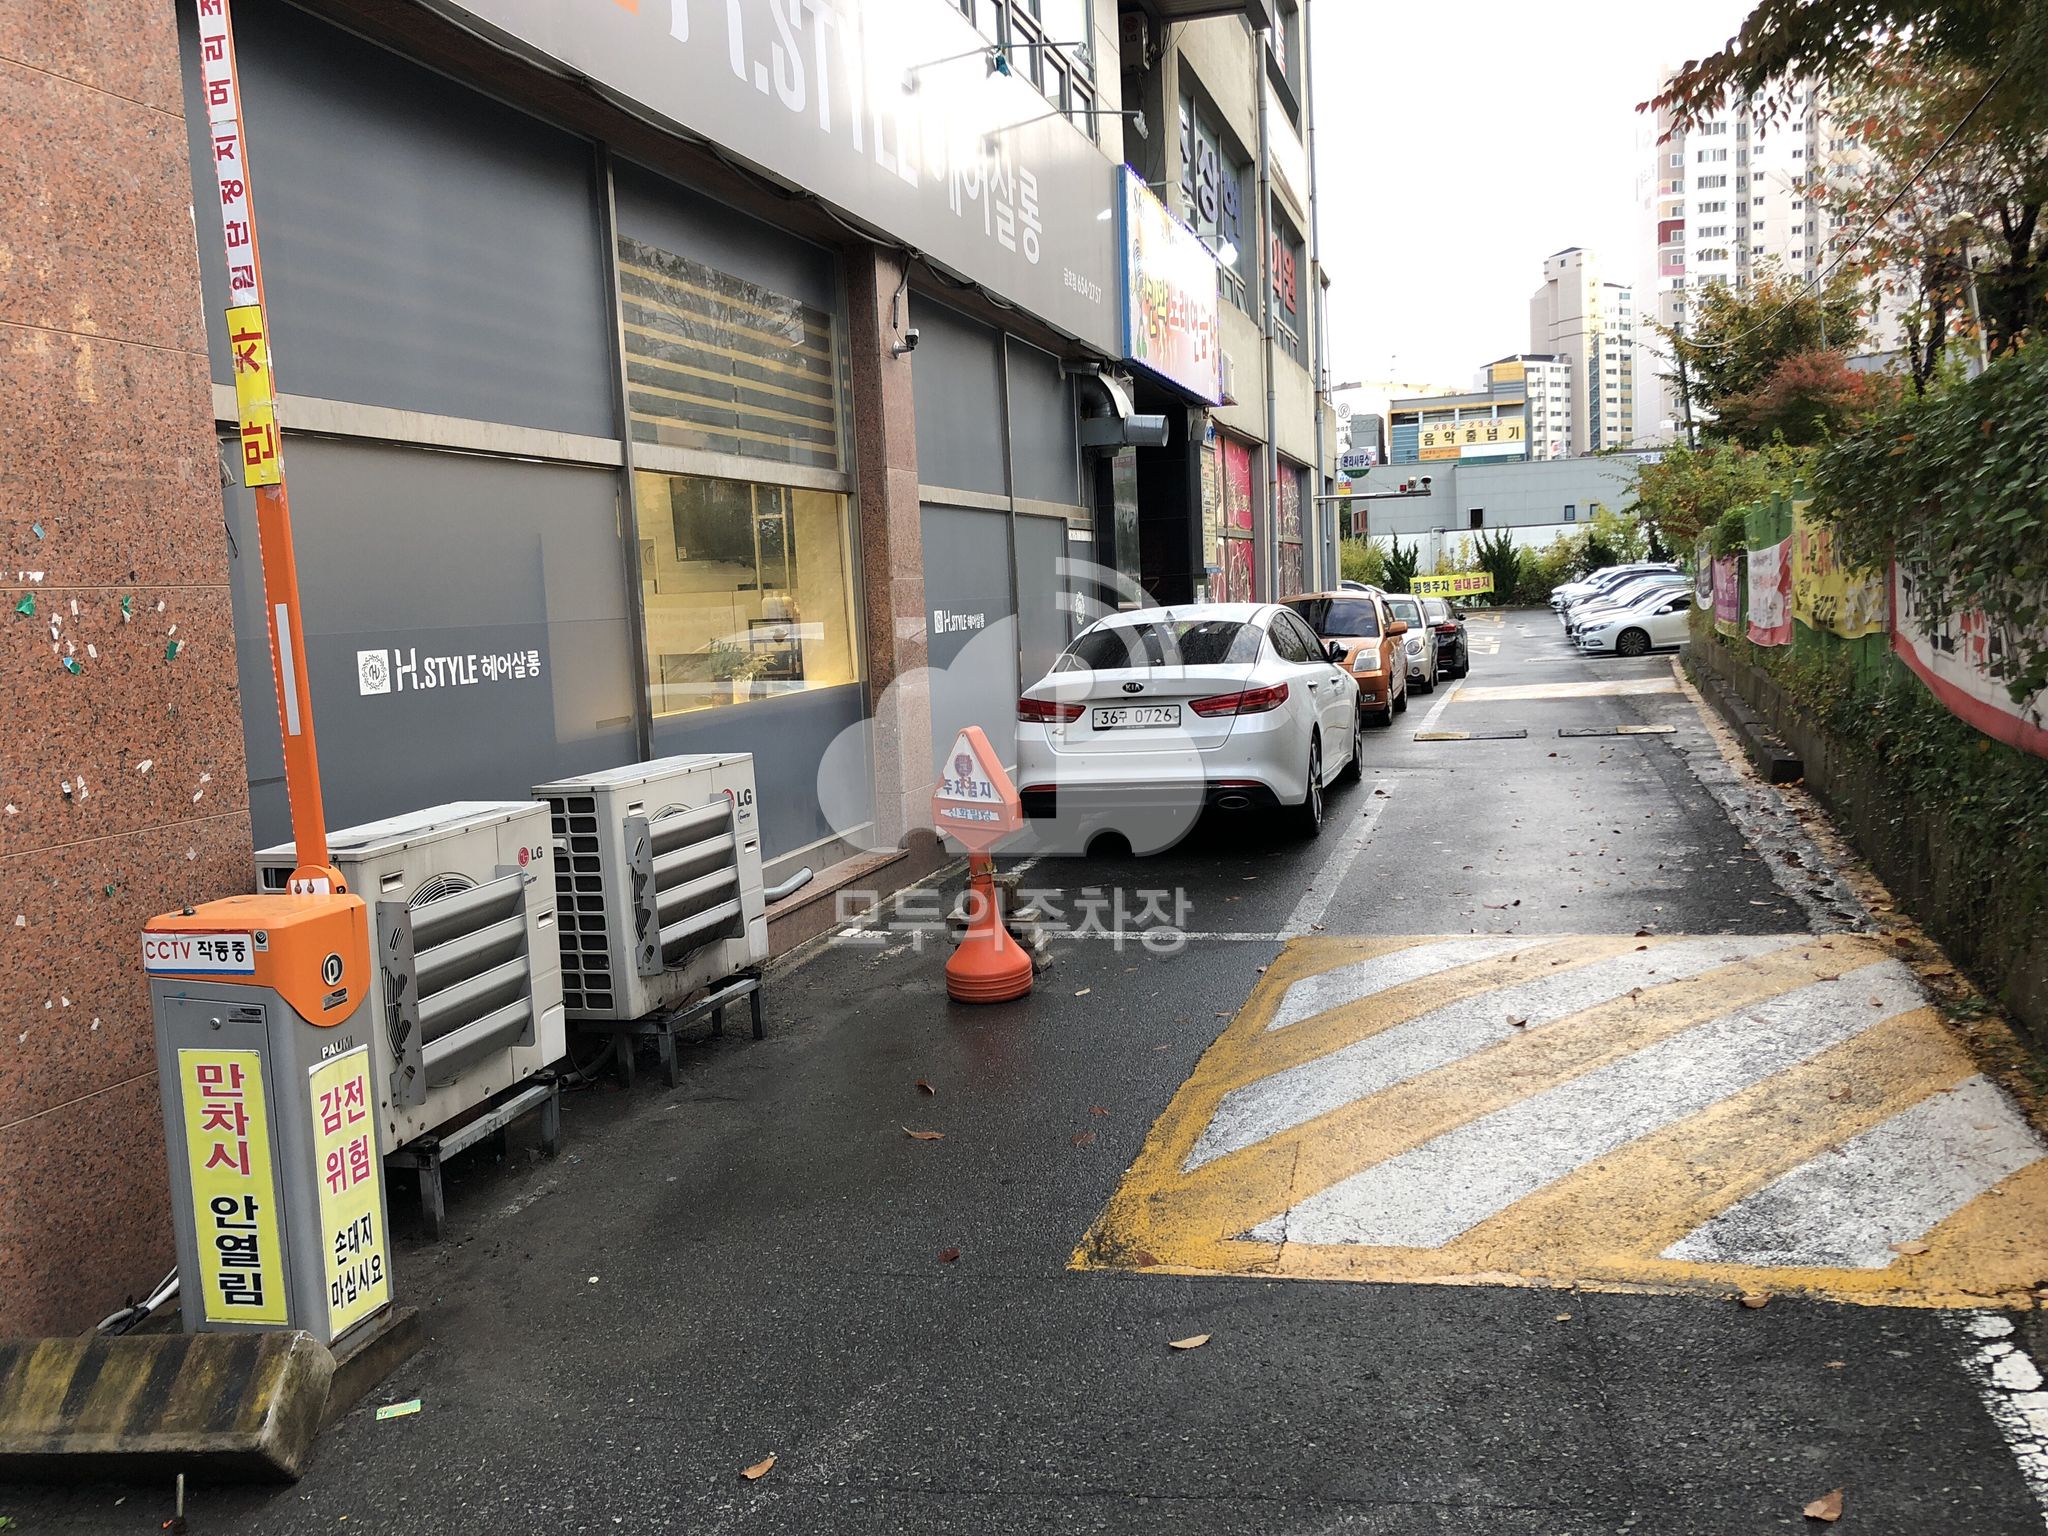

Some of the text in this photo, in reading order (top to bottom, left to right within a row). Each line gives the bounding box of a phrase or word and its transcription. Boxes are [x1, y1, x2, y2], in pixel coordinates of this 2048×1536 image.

[215, 134, 255, 290] 일단정지
[232, 327, 275, 466] 만차
[1343, 455, 1370, 468] 관리사무소
[1413, 576, 1490, 594] 평행주차 절대금지
[394, 648, 541, 692] H.STYLE 헤어살롱
[1124, 683, 1141, 691] KIA
[1101, 708, 1172, 725] 36구 0726
[737, 788, 752, 807] LG
[531, 846, 543, 861] LG
[145, 941, 246, 962] CCTV 작동중
[197, 1063, 250, 1176] 만차시
[319, 1074, 366, 1137] 감전
[325, 1134, 371, 1195] 위험
[210, 1195, 264, 1306] 안열림
[335, 1212, 373, 1266] 손대지
[331, 1254, 384, 1310] 마십시요
